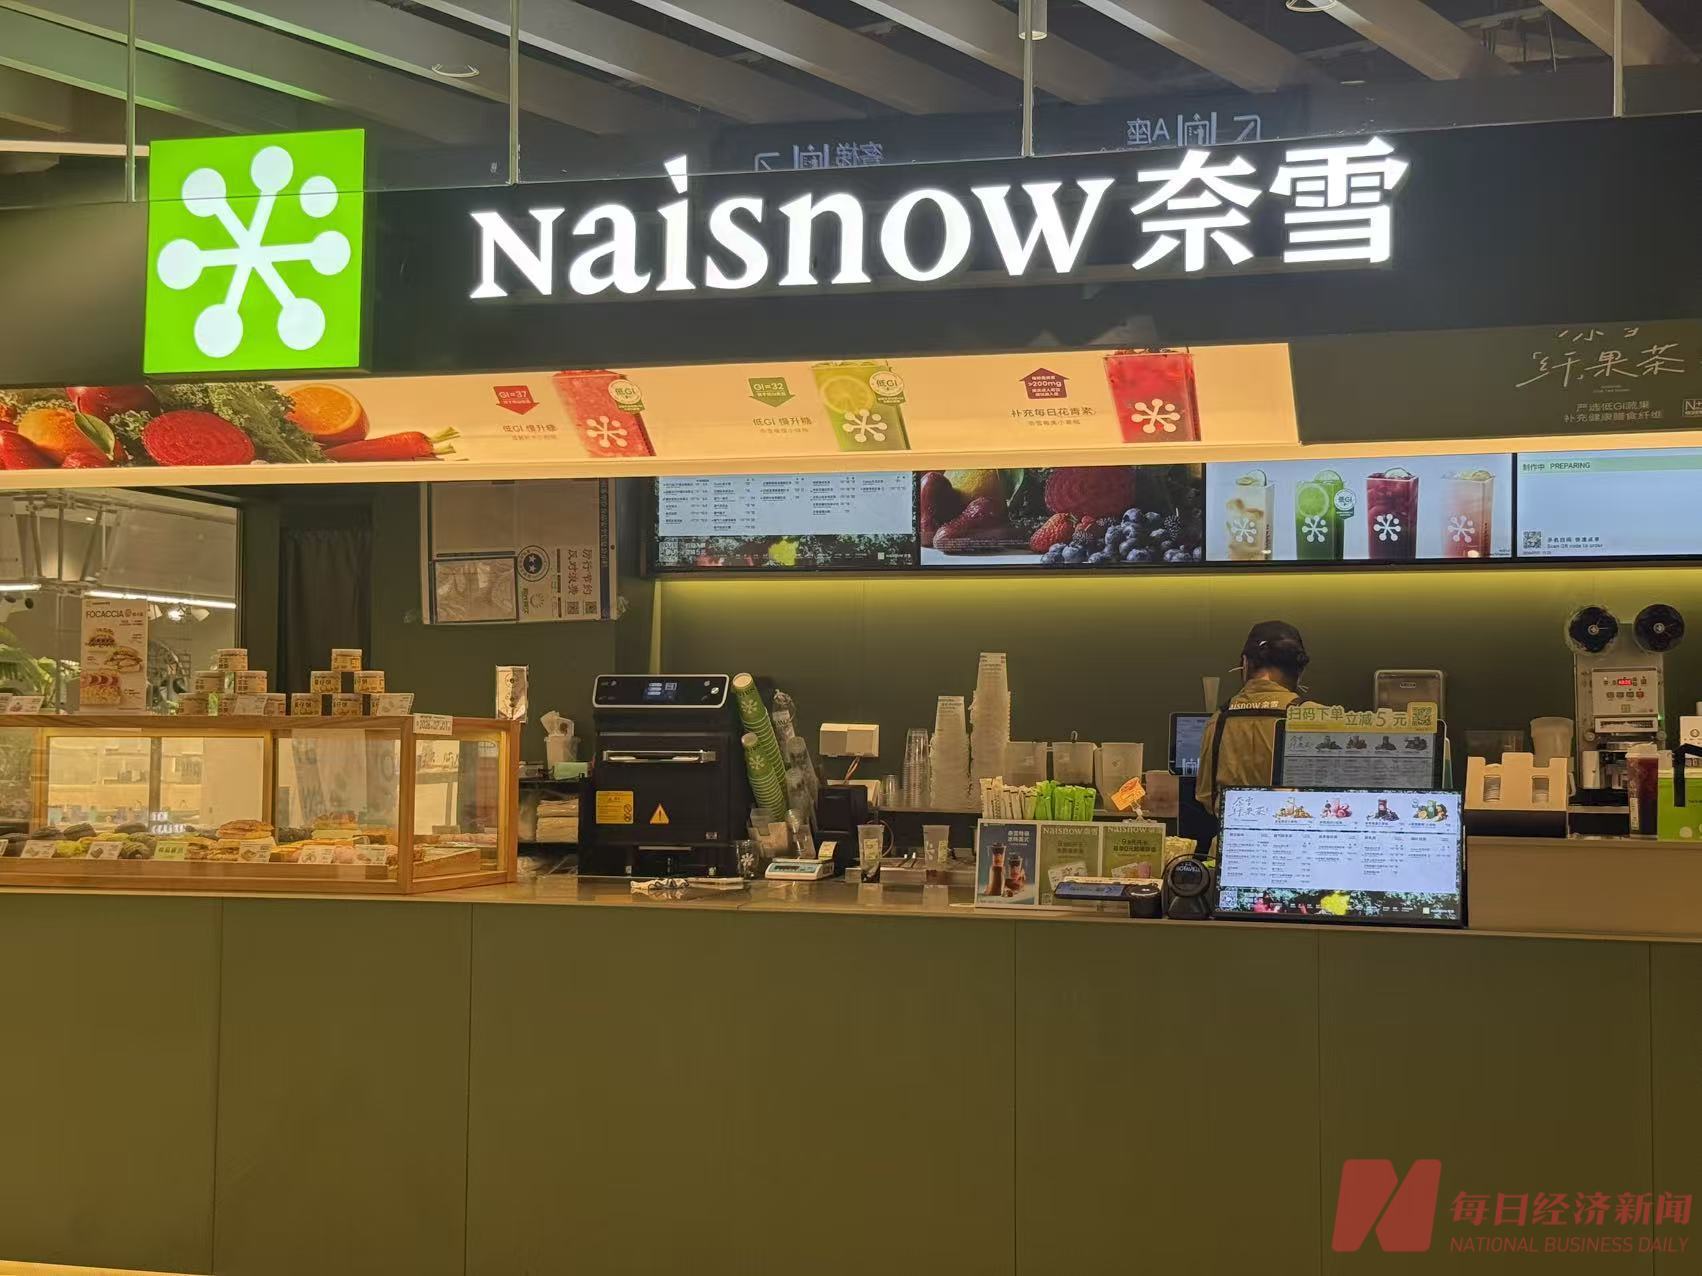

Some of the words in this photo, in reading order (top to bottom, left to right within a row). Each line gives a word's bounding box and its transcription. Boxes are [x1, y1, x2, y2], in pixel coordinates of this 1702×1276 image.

[469, 154, 1116, 300] Naisnow
[1131, 137, 1410, 273] 奈雪
[753, 382, 785, 391] GI=32
[1549, 461, 1592, 471] PREPARING
[86, 609, 125, 620] FOCACCIA
[1288, 706, 1344, 721] 扫码下单
